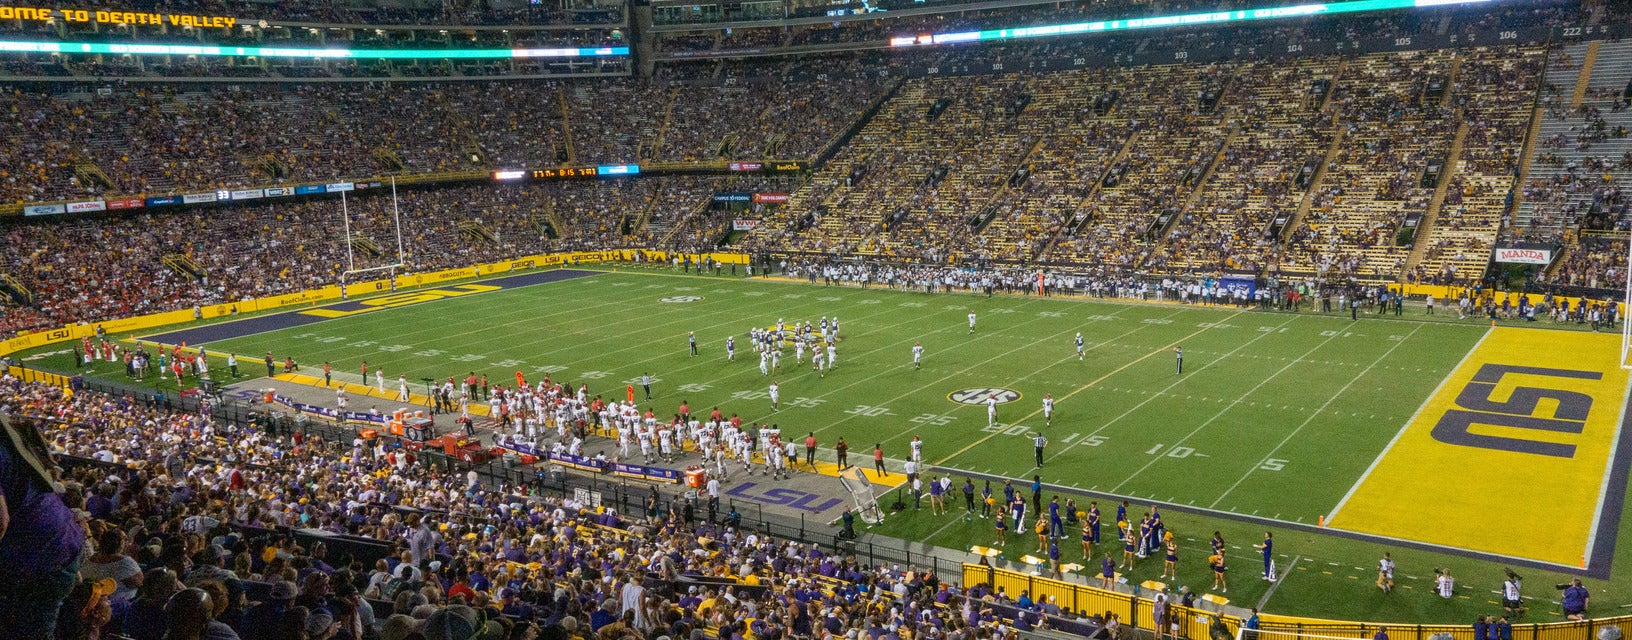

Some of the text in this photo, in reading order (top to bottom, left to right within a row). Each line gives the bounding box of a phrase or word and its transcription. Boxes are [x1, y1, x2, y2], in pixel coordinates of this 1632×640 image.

[0, 6, 236, 28] OME TO DEATH VALLEY
[1500, 31, 1517, 40] 106
[1563, 27, 1581, 36] 222
[1395, 37, 1411, 46] 105
[1073, 58, 1085, 66] 102
[1174, 52, 1187, 60] 103
[217, 190, 229, 199] 33
[545, 256, 560, 265] LSU
[571, 253, 600, 261] GEICO
[1501, 249, 1544, 261] MANDA
[297, 284, 503, 318] LSU
[46, 329, 70, 342] LSU
[783, 397, 824, 408] 35
[844, 405, 888, 417] 30
[1430, 363, 1603, 458] LSU
[909, 413, 957, 426] 25
[980, 423, 1031, 435] 20
[1062, 433, 1109, 447] 15
[1146, 444, 1195, 458] 10
[1260, 458, 1289, 471] 5
[725, 482, 843, 511] LSU
